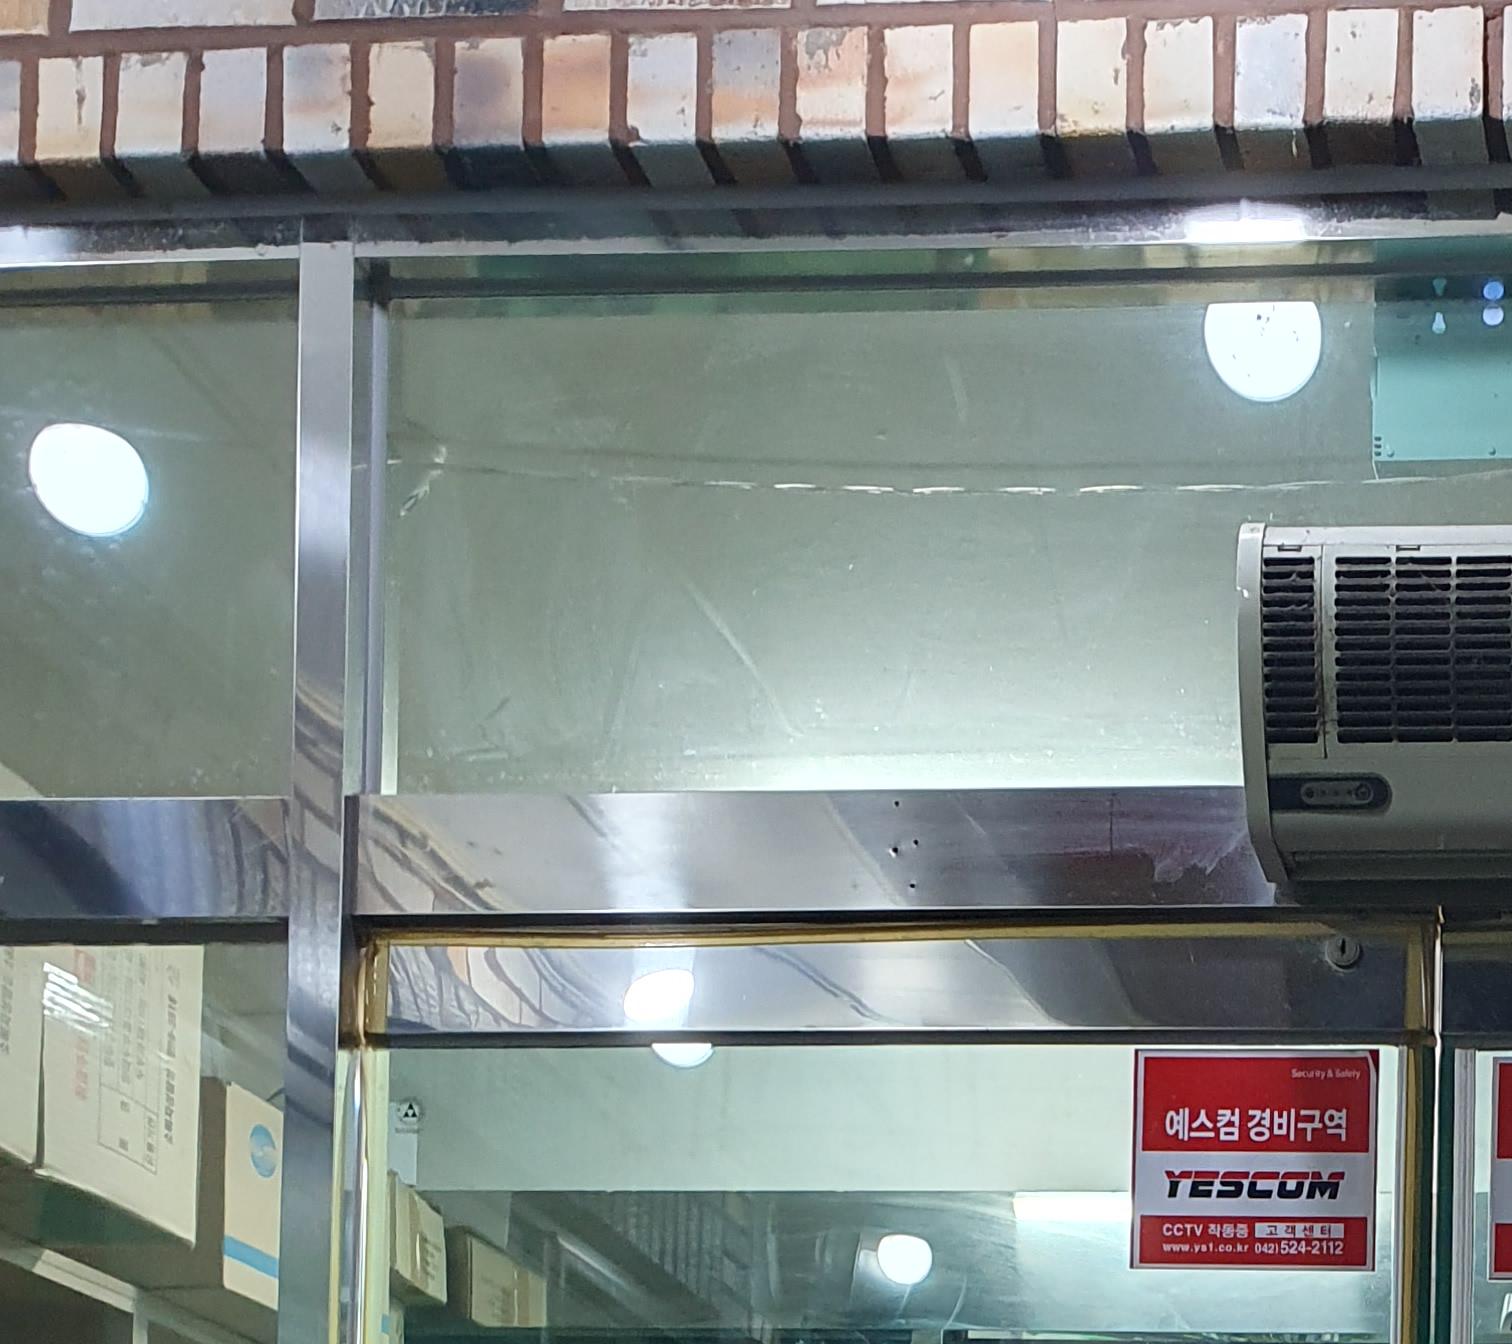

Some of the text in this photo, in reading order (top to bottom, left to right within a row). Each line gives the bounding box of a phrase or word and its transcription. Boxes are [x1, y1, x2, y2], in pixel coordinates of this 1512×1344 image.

[1165, 1107, 1348, 1142] 예스컴 경비구역
[1164, 1170, 1346, 1200] YESCOM
[1162, 1223, 1203, 1237] CCTV
